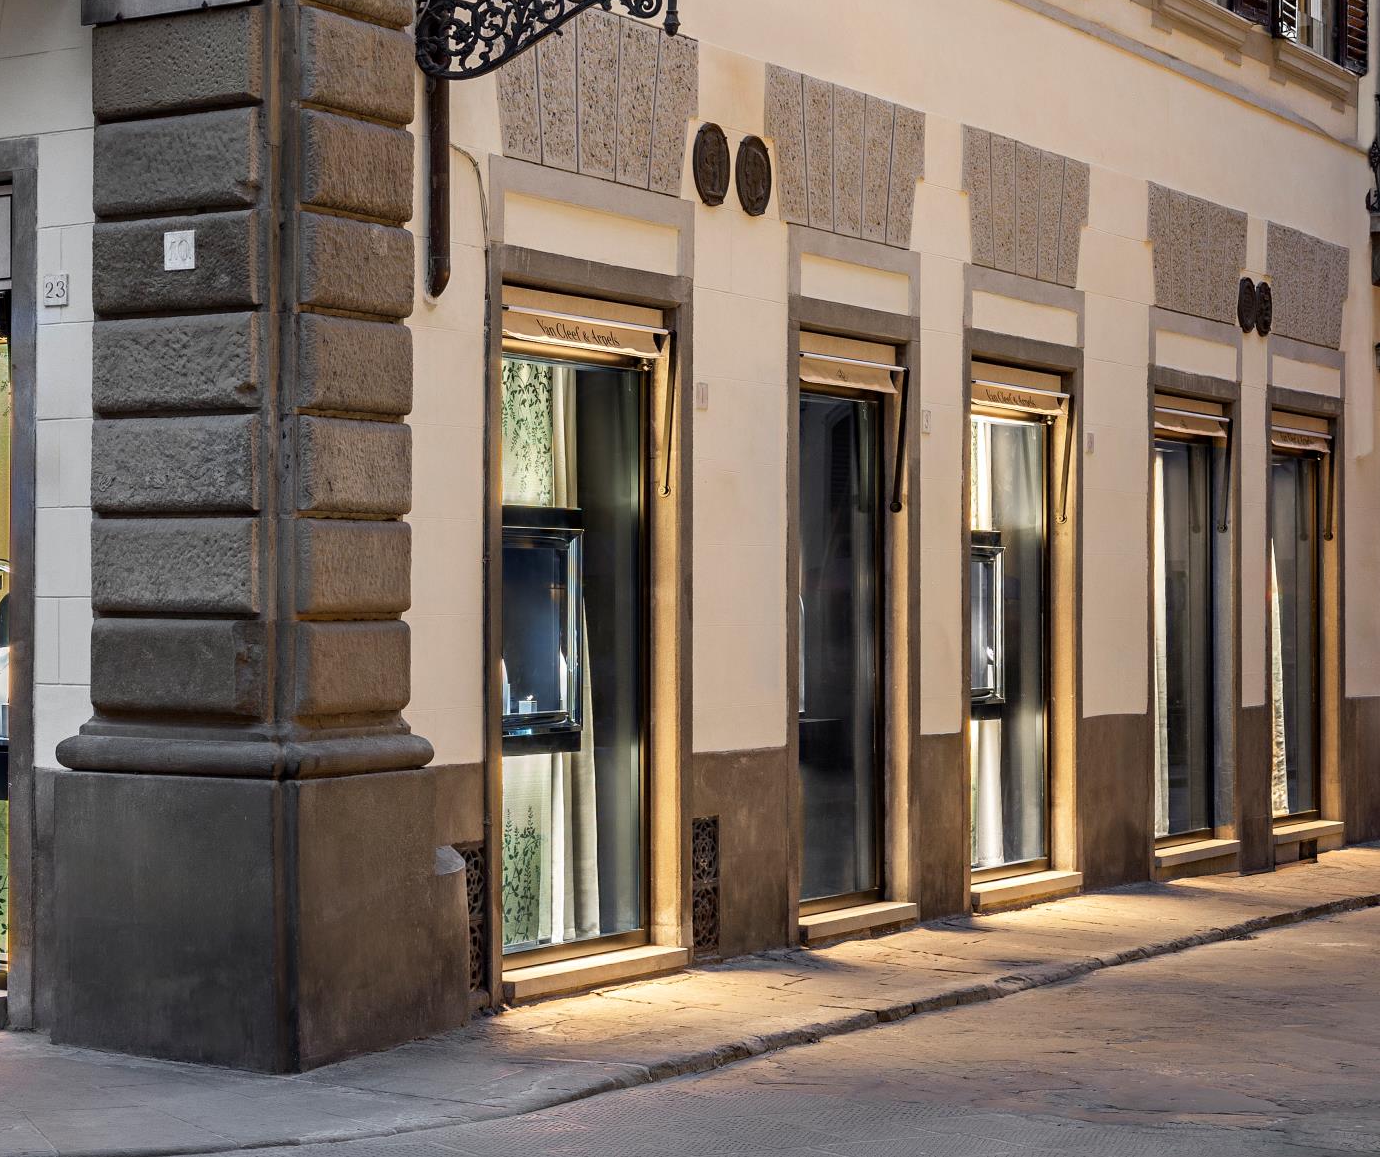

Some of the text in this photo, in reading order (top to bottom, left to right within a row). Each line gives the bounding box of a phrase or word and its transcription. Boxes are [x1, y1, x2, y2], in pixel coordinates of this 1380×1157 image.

[45, 280, 66, 299] 23
[535, 318, 558, 337] Van
[556, 322, 582, 342] Cleef
[582, 330, 591, 343] &
